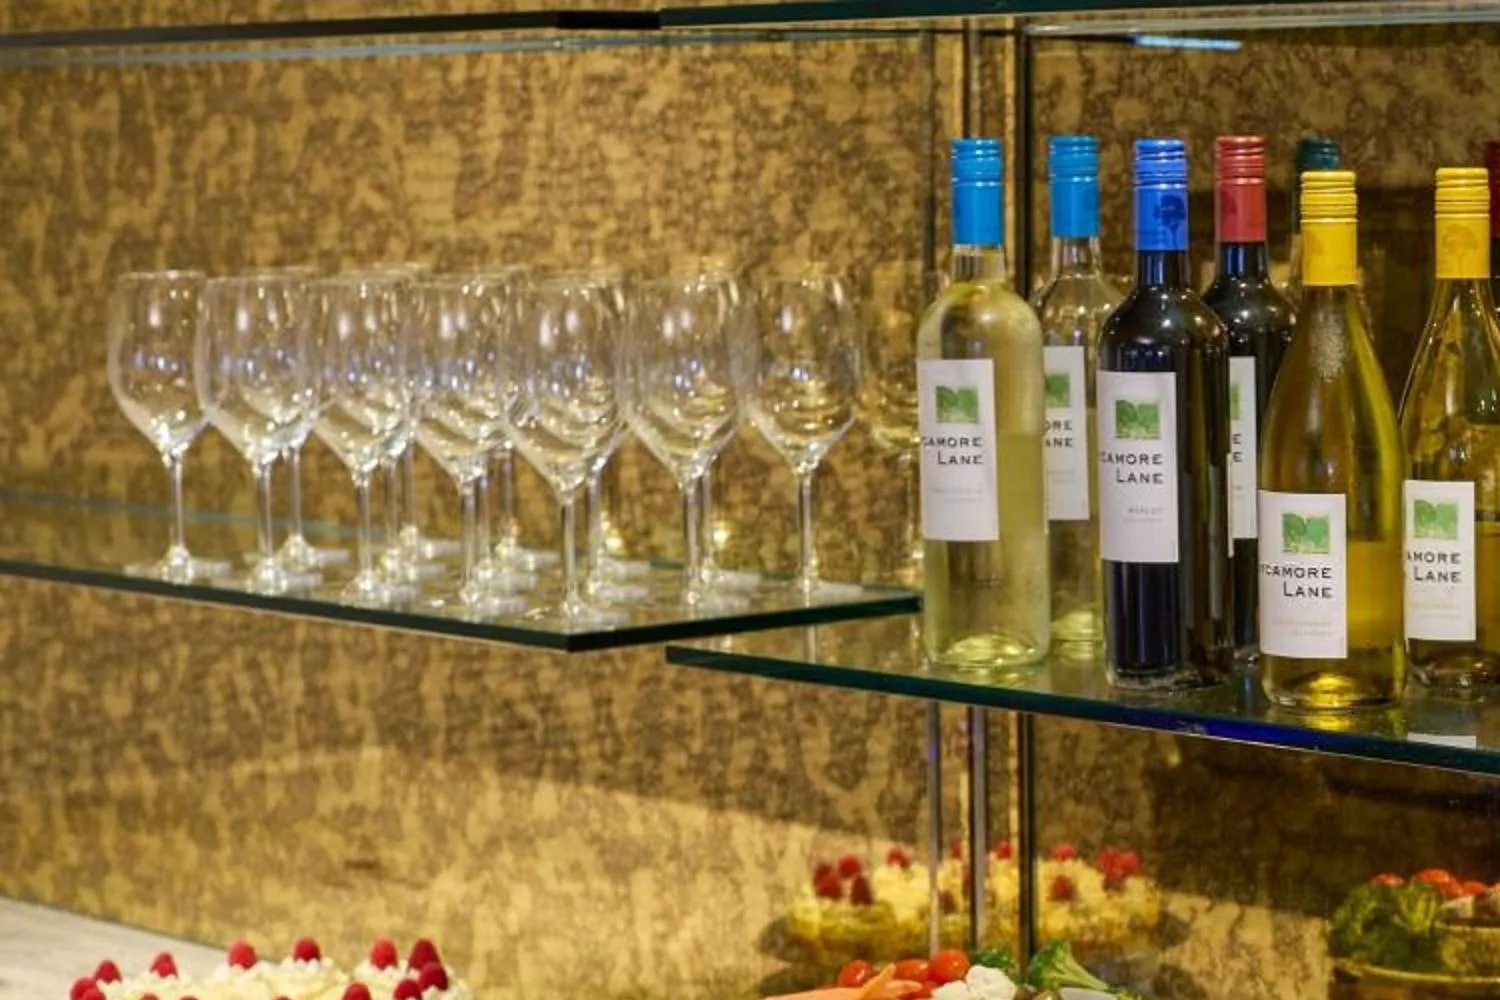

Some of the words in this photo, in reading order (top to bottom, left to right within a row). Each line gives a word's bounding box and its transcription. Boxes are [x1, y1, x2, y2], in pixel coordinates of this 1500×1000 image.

[937, 451, 983, 465] LANE
[1116, 467, 1163, 484] LANE
[1414, 566, 1461, 583] LANE
[1283, 581, 1333, 598] LANE
